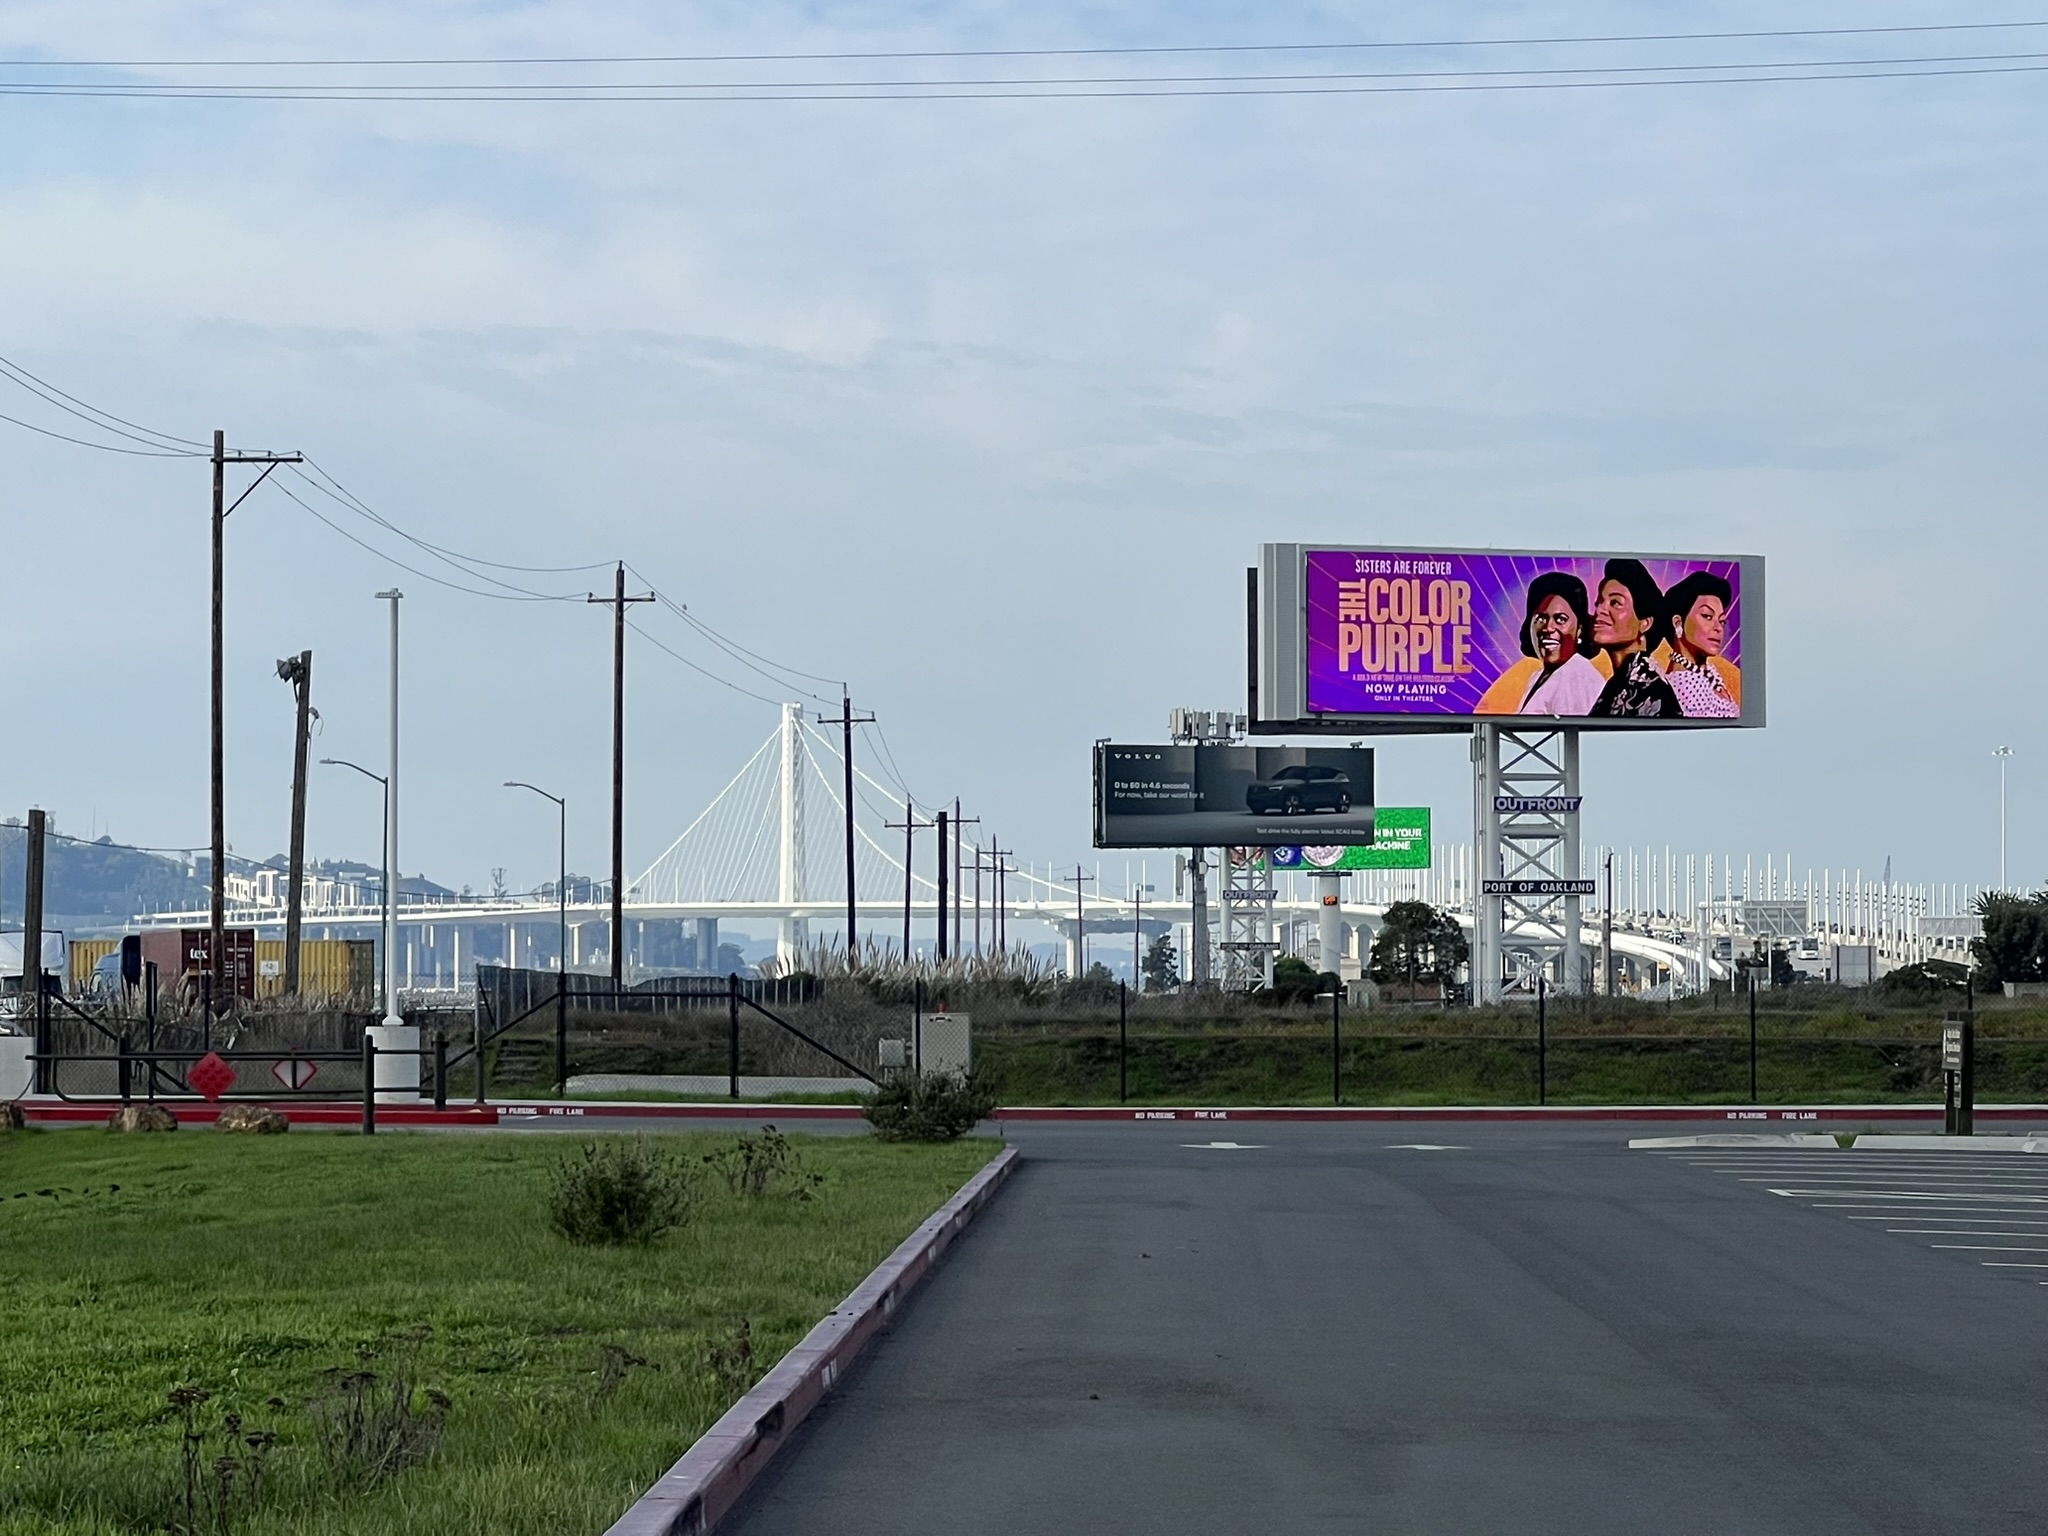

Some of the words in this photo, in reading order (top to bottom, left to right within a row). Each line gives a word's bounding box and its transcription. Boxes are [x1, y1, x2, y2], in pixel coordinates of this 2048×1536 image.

[1355, 559, 1391, 574] SISTERS
[1393, 560, 1411, 574] ARE
[1413, 561, 1452, 575] FOREVER
[1339, 578, 1366, 621] THE
[1368, 578, 1471, 625] COLOR
[1339, 622, 1473, 673] PURPLE
[1365, 683, 1394, 693] NOW
[1398, 684, 1447, 694] PLAYING
[1496, 798, 1578, 810] OUTFRONT
[1383, 828, 1393, 837] IN
[1395, 828, 1422, 837] YOUR
[1484, 882, 1513, 892] PORT
[1519, 882, 1534, 892] OF
[1540, 882, 1594, 892] OAKLAND
[1224, 891, 1277, 899] OUTFRONT
[190, 948, 208, 959] tex
[509, 1107, 537, 1115] PARKING
